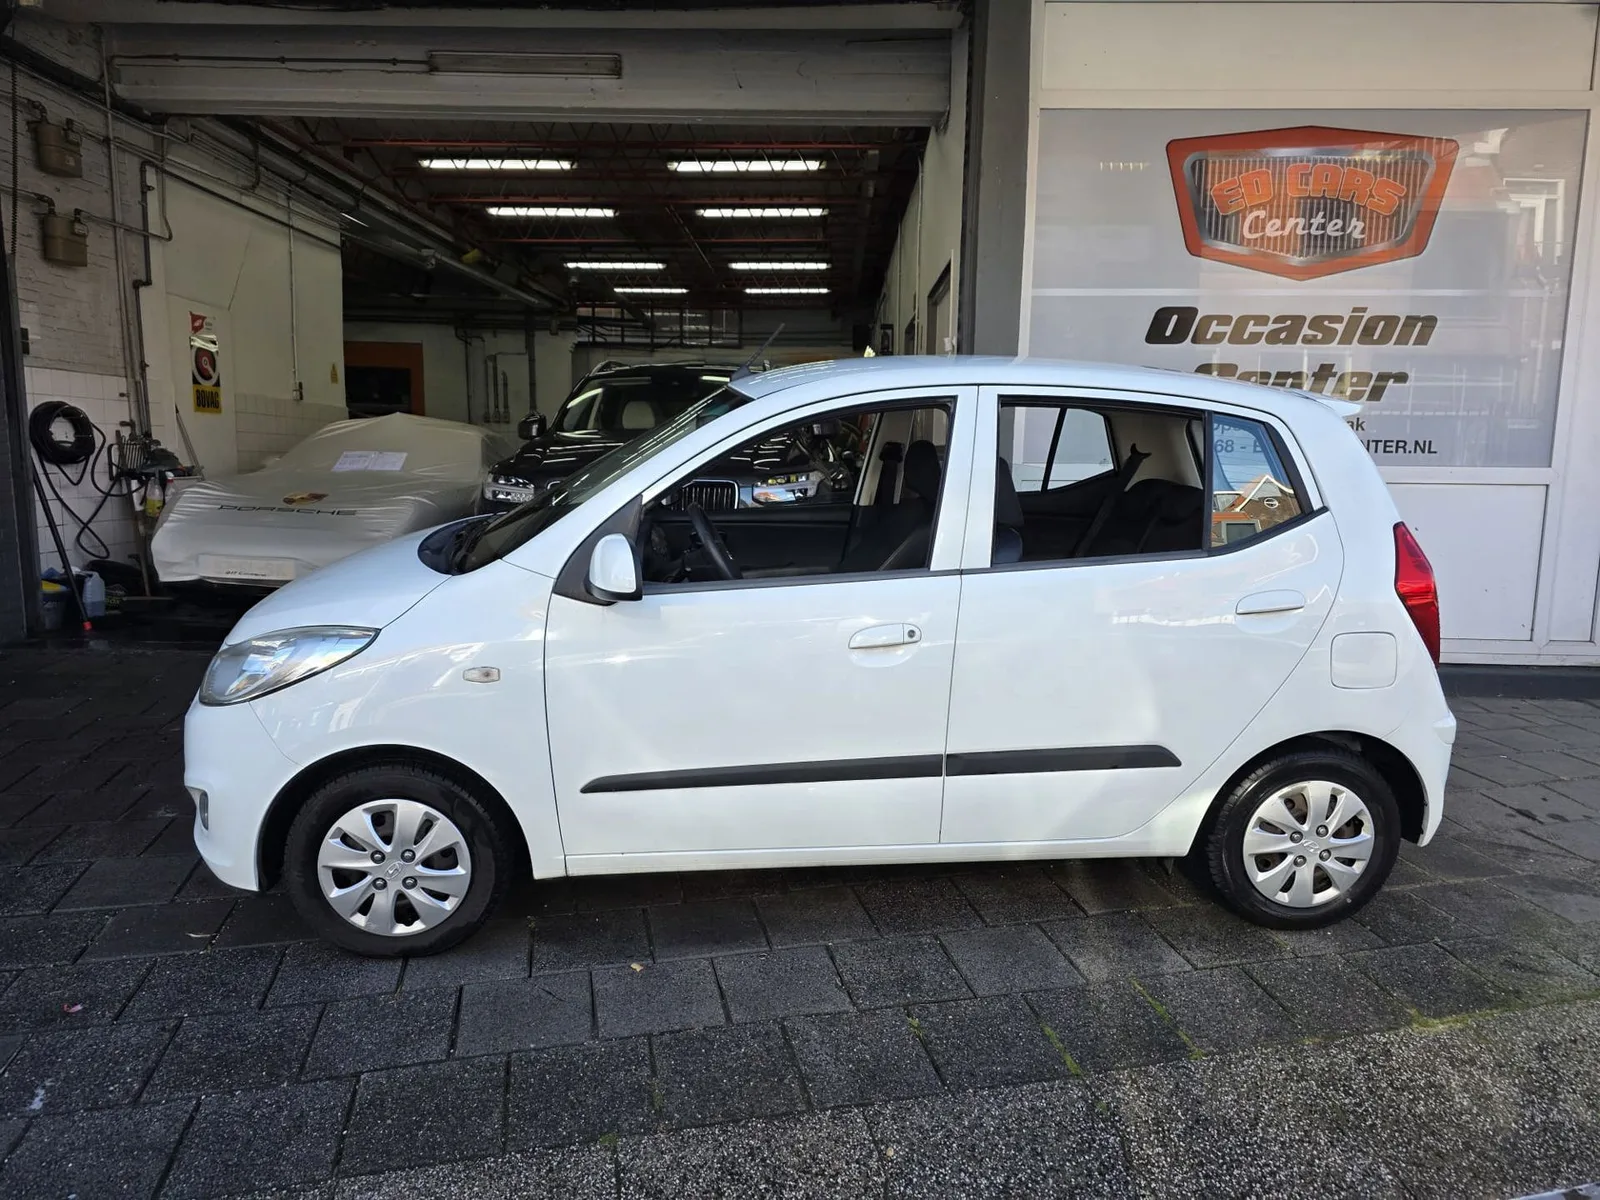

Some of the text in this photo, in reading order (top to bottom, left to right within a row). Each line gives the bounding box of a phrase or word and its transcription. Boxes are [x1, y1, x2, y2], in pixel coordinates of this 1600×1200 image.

[1211, 163, 1407, 216] ED CARS
[1242, 210, 1366, 239] Center
[1144, 306, 1438, 346] Occasion
[195, 388, 220, 410] BOVAG
[218, 504, 357, 516] PORSCHE
